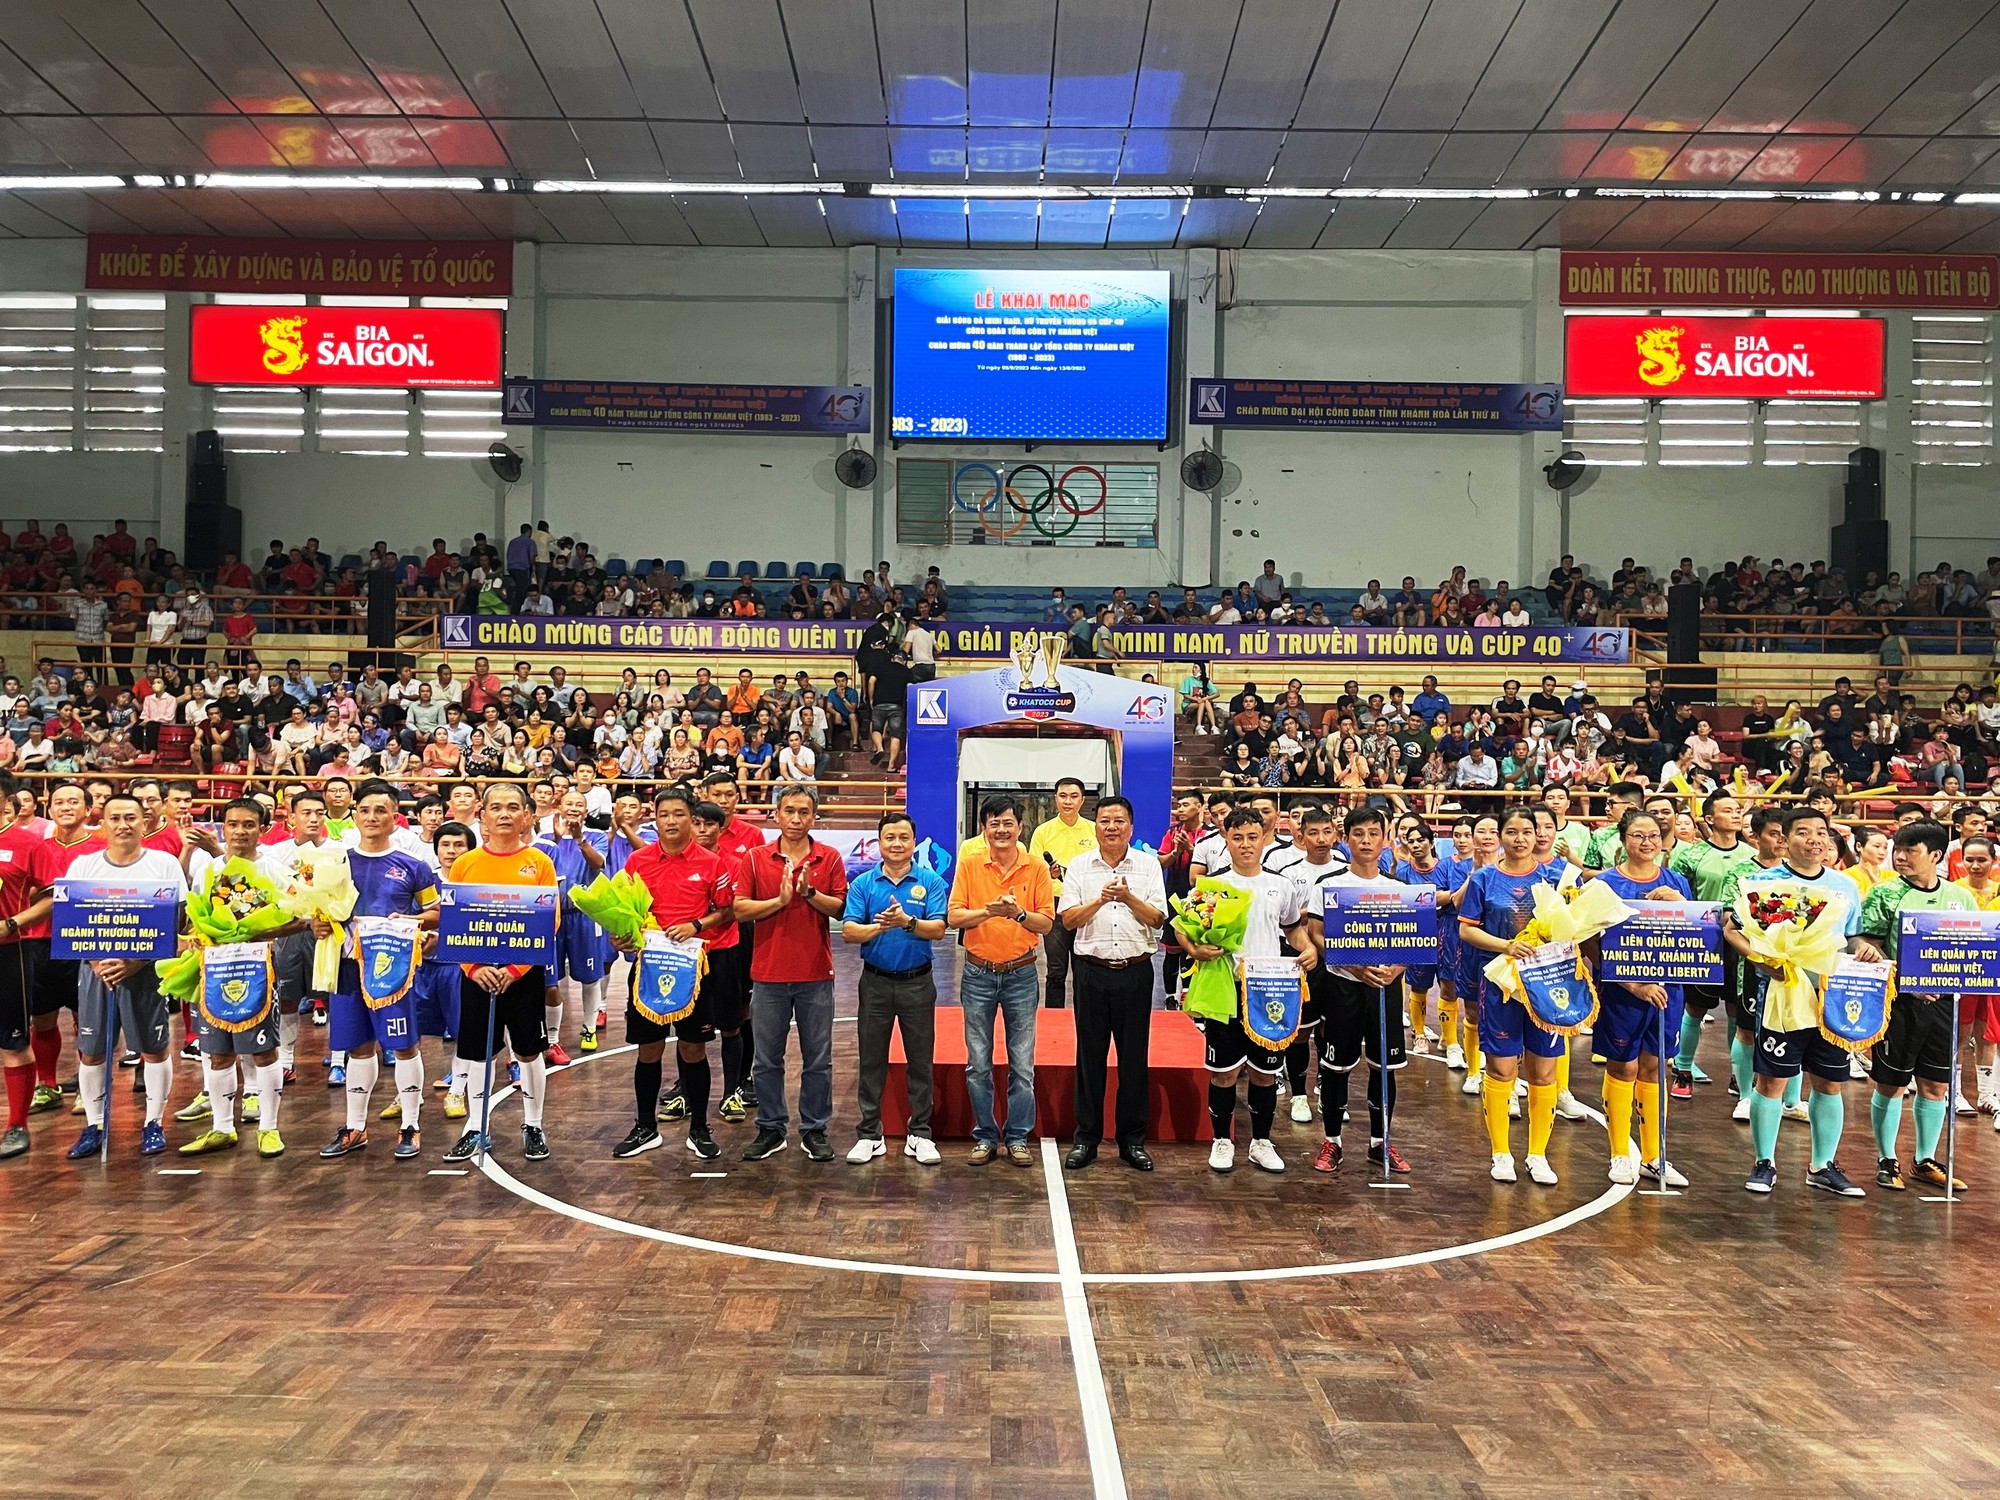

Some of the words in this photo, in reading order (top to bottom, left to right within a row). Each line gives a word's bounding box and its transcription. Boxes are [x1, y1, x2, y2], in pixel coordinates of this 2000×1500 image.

[100, 244, 152, 276] KHỎE
[159, 242, 188, 278] ĐỂ
[192, 249, 232, 278] XÂY
[238, 252, 293, 284] DỰNG
[300, 252, 324, 281] VÀ
[332, 250, 372, 282] BẢO
[378, 253, 404, 288] VỆ
[410, 247, 438, 283] TỔ
[442, 250, 496, 287] QUỐC
[1568, 262, 1614, 294] ĐOÀN
[1621, 257, 1657, 296] KẾT,
[1663, 267, 1720, 294] TRUNG
[1725, 266, 1776, 300] THỰC,
[1782, 268, 1816, 295] CAO
[1822, 266, 1890, 300] THƯỢNG
[1896, 264, 1919, 296] VÀ
[1924, 260, 1961, 296] TIẾN
[1967, 266, 1991, 302] BỘ
[1001, 293, 1042, 310] KHAI
[1049, 293, 1090, 312] MẠC
[356, 326, 390, 341] BIA
[1735, 336, 1770, 352] BIA
[593, 406, 606, 418] 40
[930, 417, 968, 436] 2023)
[478, 618, 536, 644] CHÀO
[545, 620, 612, 645] MỪNG
[620, 621, 663, 646] CÁC
[670, 622, 713, 650] VẬN
[721, 622, 781, 652] ĐỘNG
[788, 624, 836, 649] VIÊN
[958, 624, 1002, 652] GIẢI
[1113, 632, 1165, 653] MINI
[1174, 632, 1231, 656] NAM,
[1240, 628, 1270, 654] NỮ
[1276, 626, 1358, 655] TRUYỀN
[1366, 627, 1438, 656] THỐNG
[1446, 630, 1474, 656] VÀ
[1482, 631, 1526, 656] CÚP
[1018, 698, 1054, 706] KHATOCO
[1055, 698, 1072, 706] CUP
[88, 913, 110, 924] LIÊN
[112, 914, 140, 925] QUÂN
[468, 919, 492, 932] LIÊN
[496, 920, 525, 934] QUÂN
[61, 926, 94, 938] NGÀNH
[97, 927, 136, 938] THƯƠNG
[139, 928, 158, 940] MẠI
[1344, 920, 1372, 934] CÔNG
[1375, 922, 1388, 933] TY
[1390, 922, 1418, 933] TNHH
[72, 941, 96, 952] DỊCH
[98, 941, 112, 952] VỤ
[114, 941, 128, 951] DU
[130, 941, 154, 952] LỊCH
[446, 933, 484, 946] NGÀNH
[486, 936, 498, 947] IN
[509, 937, 531, 948] BAO
[534, 936, 546, 948] BÌ
[1324, 937, 1366, 948] THƯƠNG
[1368, 937, 1388, 950] MẠI
[1391, 936, 1438, 948] KHATOCO
[1620, 934, 1643, 946] LIÊN
[1646, 934, 1675, 948] QUÂN
[1678, 937, 1706, 948] CVDL
[1602, 950, 1630, 961] YANG
[1632, 950, 1656, 964] BAY,
[1659, 950, 1695, 963] KHÁNH
[1698, 950, 1724, 966] TÂM,
[1920, 948, 1940, 959] LIÊN
[1942, 948, 1965, 960] QUÂN
[1968, 950, 1979, 960] VP
[1981, 950, 1998, 960] TCT
[1616, 965, 1664, 976] KHATOCO
[1668, 966, 1710, 978] LIBERTY
[1932, 960, 1960, 973] KHÁNH
[1963, 962, 1985, 975] VIỆT,
[1920, 976, 1962, 988] KHATOCO,
[1965, 976, 1994, 987] KHÁNH
[154, 1024, 164, 1042] 7
[386, 1017, 408, 1037] 20
[256, 1029, 266, 1046] 6
[1762, 1036, 1788, 1058] 86
